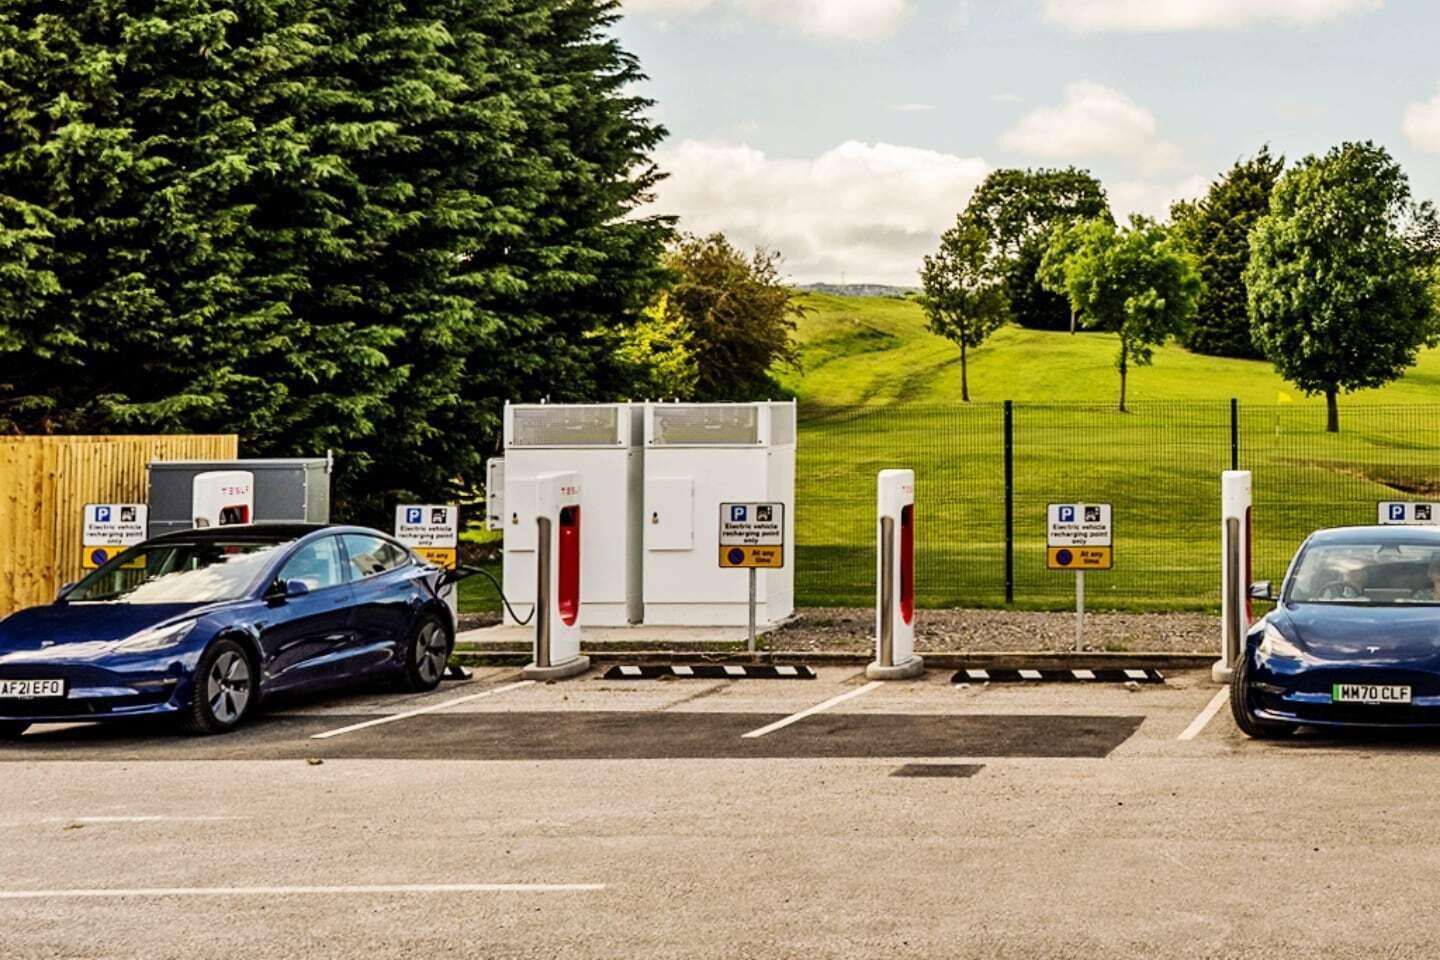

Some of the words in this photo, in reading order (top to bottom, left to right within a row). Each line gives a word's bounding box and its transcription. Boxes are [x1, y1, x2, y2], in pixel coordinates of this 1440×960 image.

[98, 508, 109, 521] P
[409, 509, 420, 522] P
[734, 507, 744, 520] P
[1061, 508, 1072, 521] P
[1392, 506, 1402, 519] P
[1342, 686, 1377, 699] MM70
[1382, 686, 1408, 700] CLF
